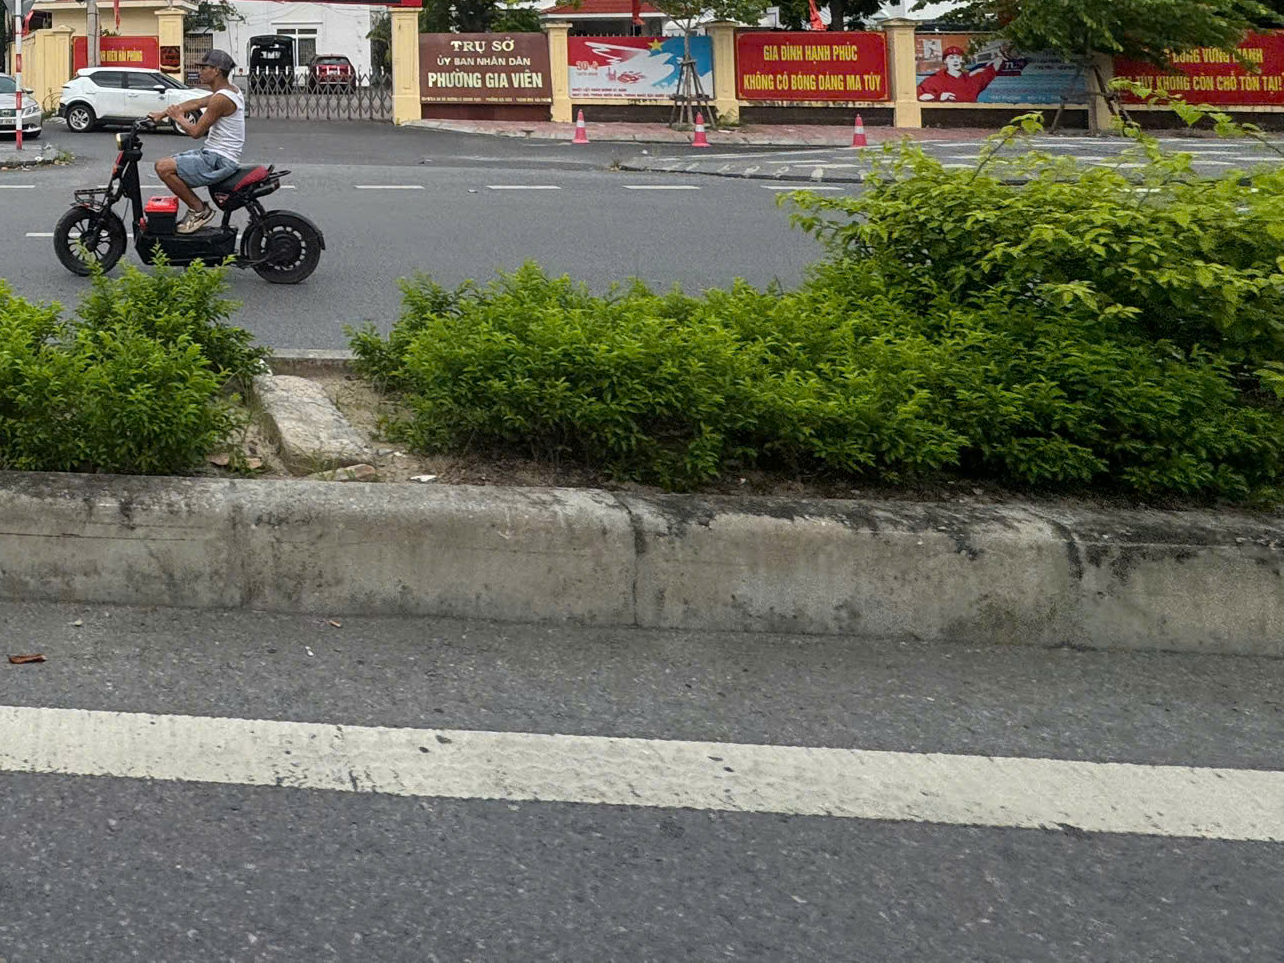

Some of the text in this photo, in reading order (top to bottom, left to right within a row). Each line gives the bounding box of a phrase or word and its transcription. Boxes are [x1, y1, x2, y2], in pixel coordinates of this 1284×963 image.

[450, 37, 515, 54] TRỤ SỞ
[763, 41, 858, 65] GIA ĐÌNH HẠNH PHÚC
[437, 55, 531, 66] ỦY BAN NHÂN DÂN
[428, 68, 543, 88] PHƯỜNG GIA VIÊN
[743, 71, 774, 91] KHÔNG
[776, 71, 789, 91] CÓ
[791, 71, 816, 91] BÓNG
[818, 71, 844, 91] DÁNG
[846, 74, 862, 91] MA
